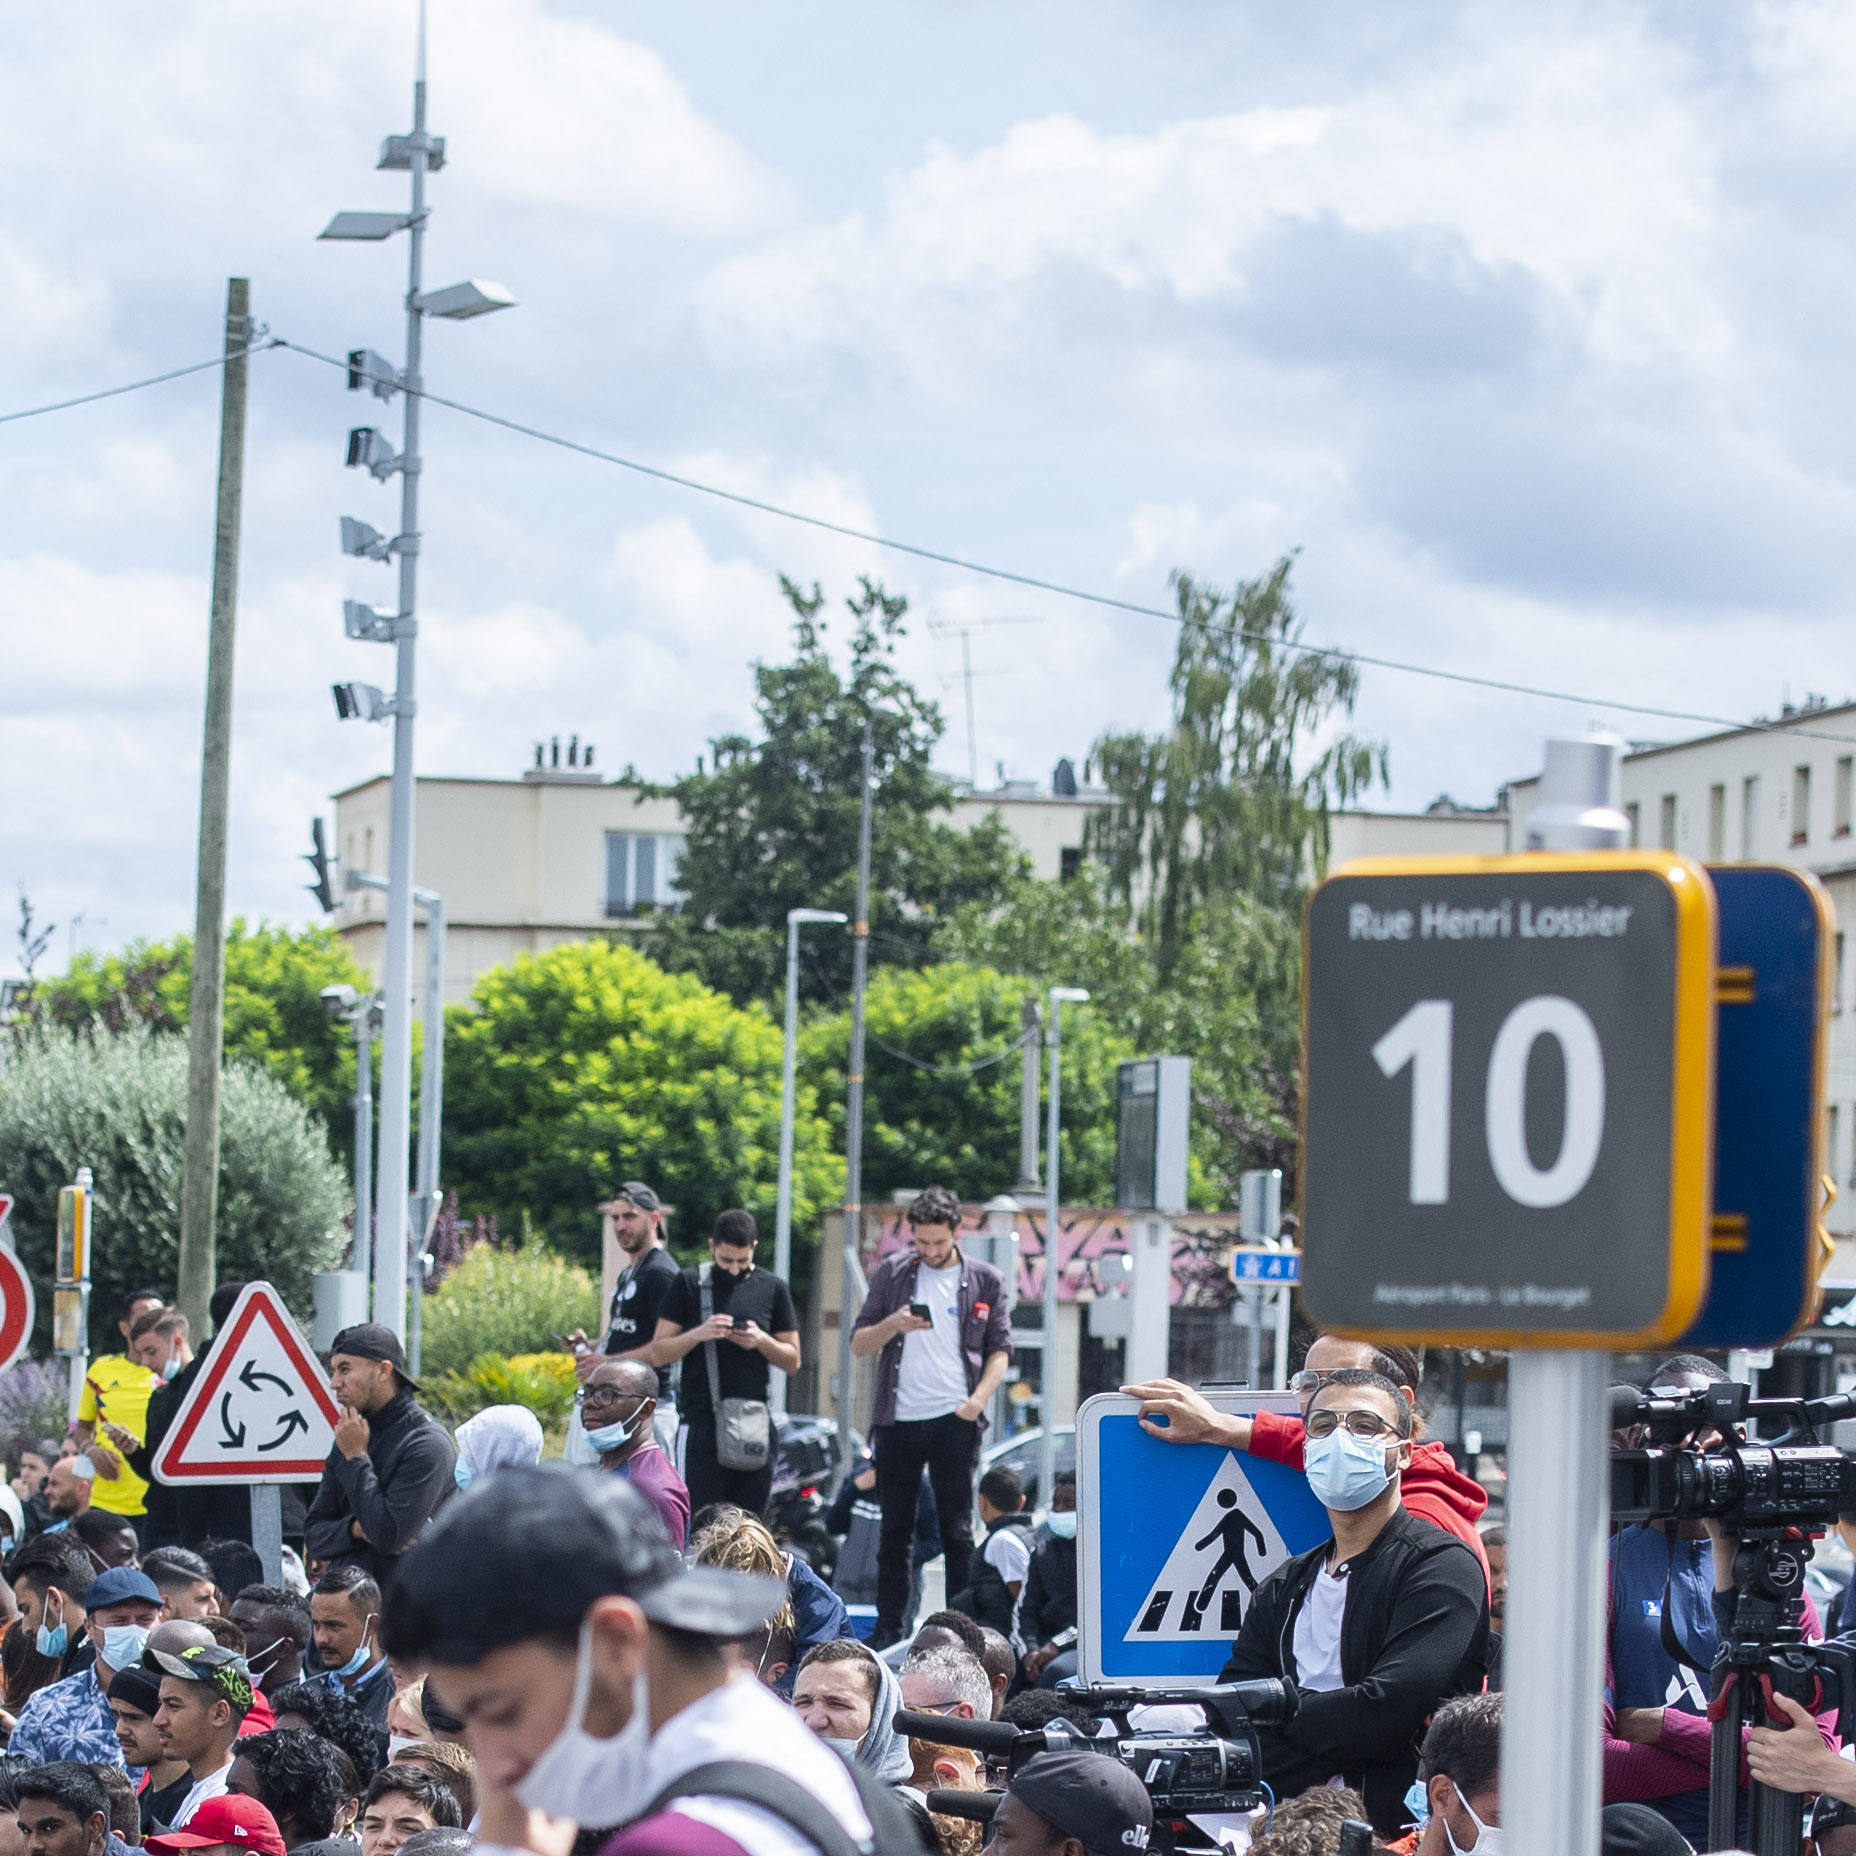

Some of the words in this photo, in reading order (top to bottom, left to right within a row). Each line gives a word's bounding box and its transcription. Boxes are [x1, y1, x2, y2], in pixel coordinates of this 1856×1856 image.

[1349, 902, 1414, 942] Rue
[1420, 900, 1511, 939] Henri
[1520, 899, 1634, 939] Lossier
[1371, 994, 1605, 1209] 10
